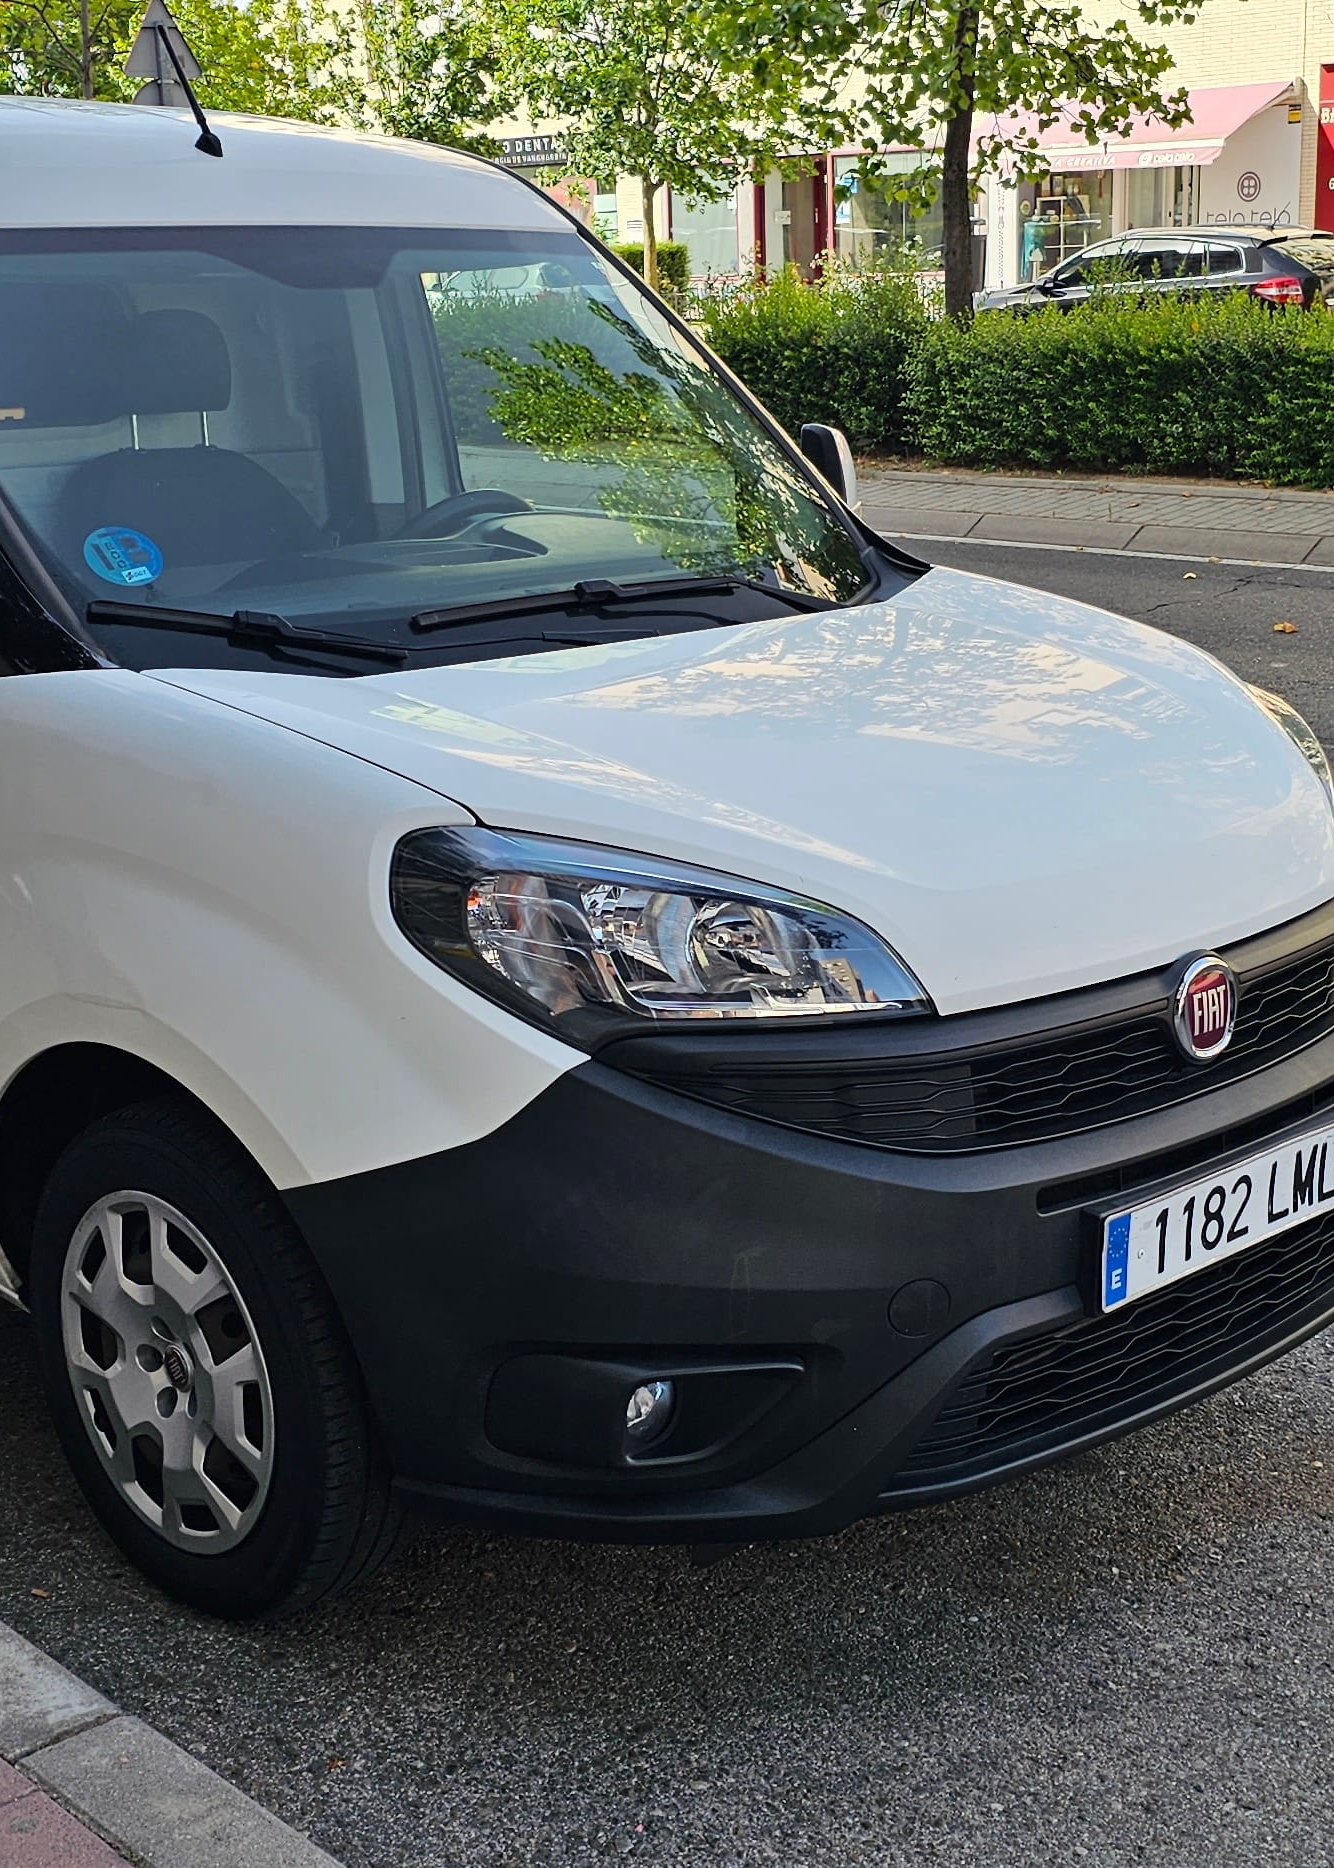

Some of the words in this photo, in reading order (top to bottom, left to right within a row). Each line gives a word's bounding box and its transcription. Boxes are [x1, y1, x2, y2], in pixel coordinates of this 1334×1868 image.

[515, 137, 560, 153] DENTA
[1192, 983, 1227, 1037] FIAT
[1155, 1174, 1253, 1274] 1182
[1110, 1267, 1123, 1290] E
